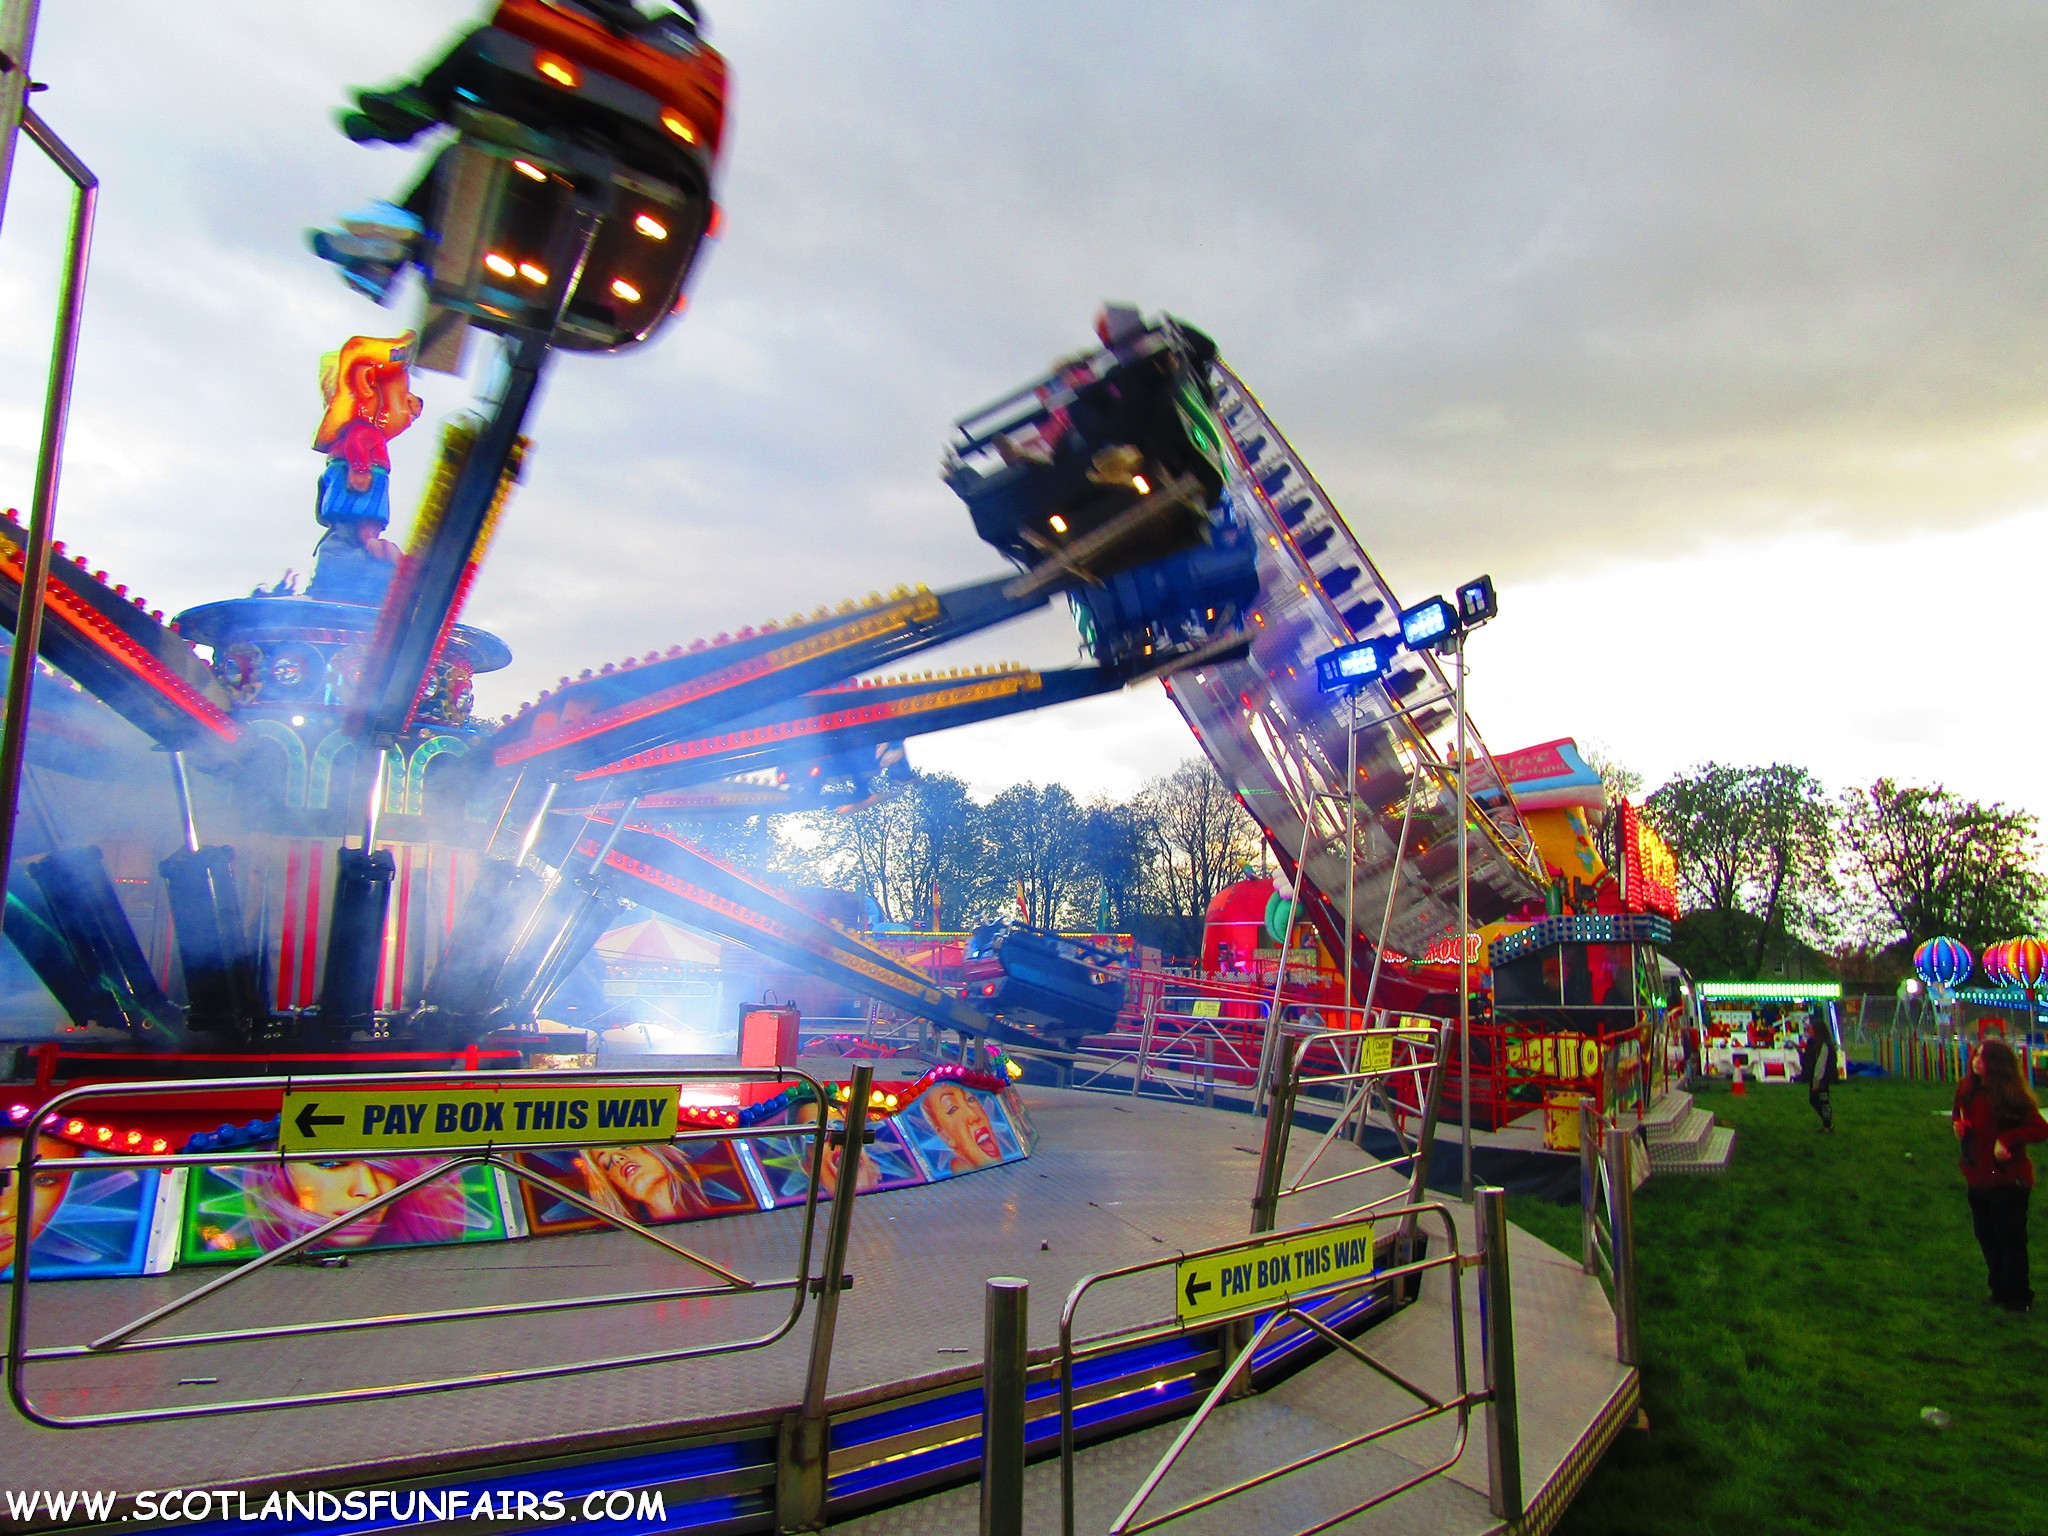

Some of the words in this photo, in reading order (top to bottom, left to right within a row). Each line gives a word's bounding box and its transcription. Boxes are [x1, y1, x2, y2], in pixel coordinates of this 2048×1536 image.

[362, 1104, 429, 1135] PAY
[435, 1102, 505, 1133] BOX
[513, 1100, 589, 1131] THIS
[597, 1098, 669, 1129] WAY
[1221, 1263, 1253, 1297] PAY
[1258, 1254, 1292, 1289] BOX
[1294, 1245, 1331, 1279] THIS
[1334, 1237, 1367, 1270] WAY
